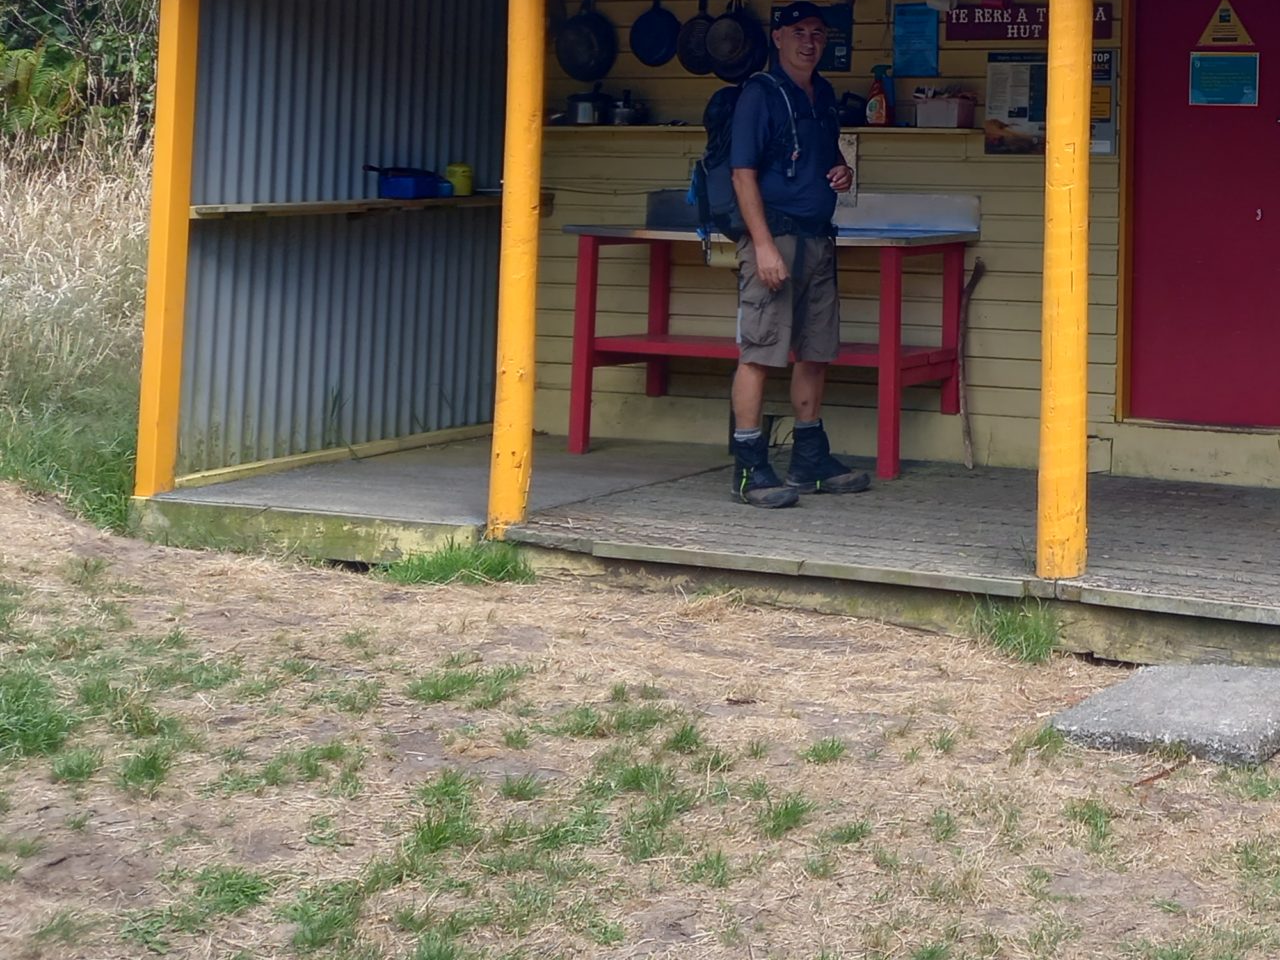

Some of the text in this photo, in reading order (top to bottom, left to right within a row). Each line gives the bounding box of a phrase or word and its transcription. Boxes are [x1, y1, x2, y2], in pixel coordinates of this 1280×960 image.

[949, 9, 969, 24] TE
[975, 8, 1012, 23] RERE
[1007, 25, 1042, 38] HUT
[1092, 53, 1110, 63] TOP
